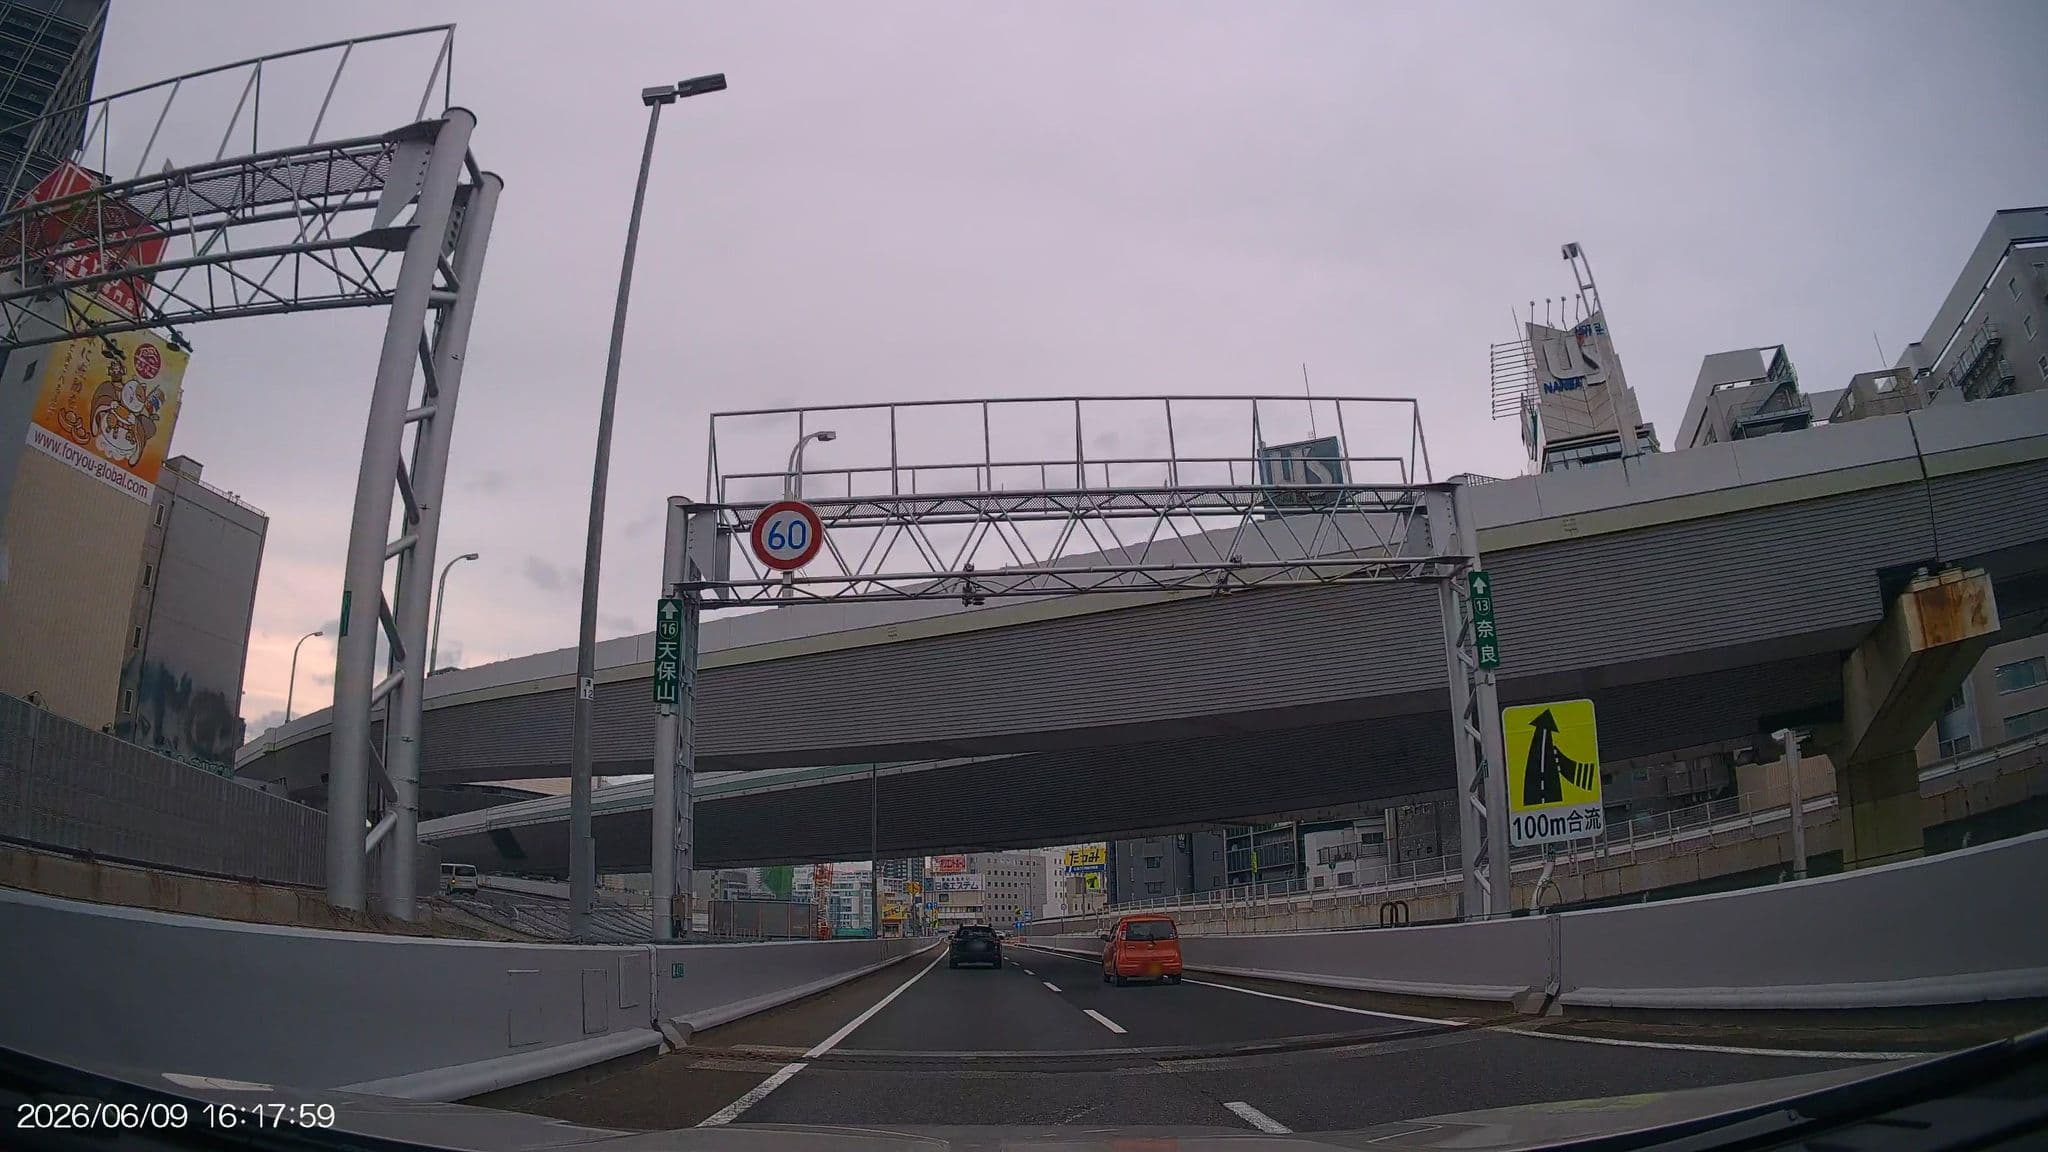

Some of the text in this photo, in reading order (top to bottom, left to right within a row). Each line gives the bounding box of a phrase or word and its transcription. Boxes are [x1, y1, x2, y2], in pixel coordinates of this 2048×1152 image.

[33, 430, 149, 499] www.foryou-global.com
[768, 520, 806, 550] 60
[1476, 600, 1497, 663] 13 奈良
[657, 623, 677, 701] 16 天保山
[583, 689, 593, 699] 12
[1513, 806, 1602, 841] 100m合流
